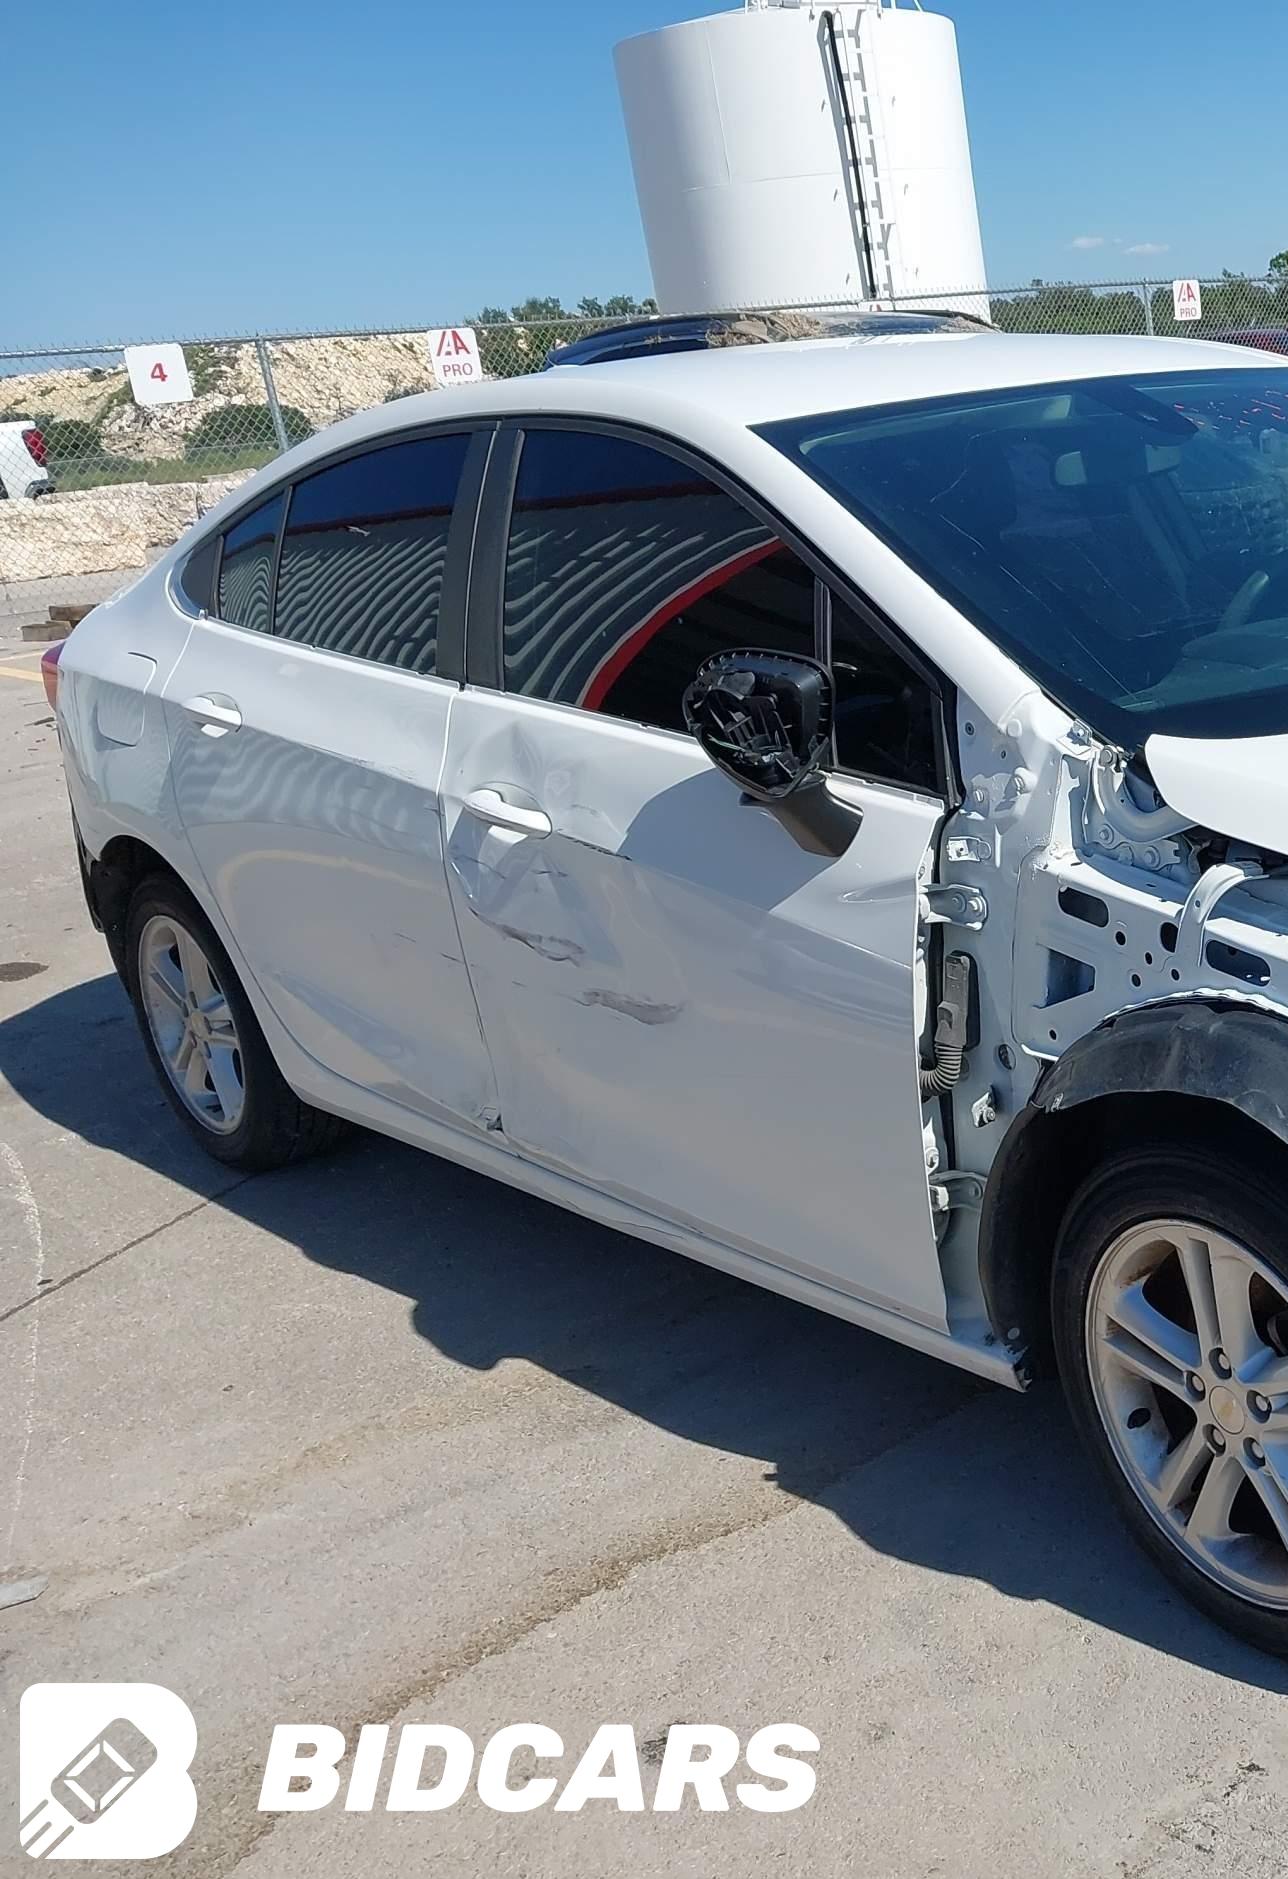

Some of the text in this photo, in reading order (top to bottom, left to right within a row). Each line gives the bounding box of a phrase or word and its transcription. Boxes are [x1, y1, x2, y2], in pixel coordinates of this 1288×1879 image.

[1180, 307, 1197, 318] PRO
[151, 363, 168, 382] 4
[443, 362, 473, 377] PRO
